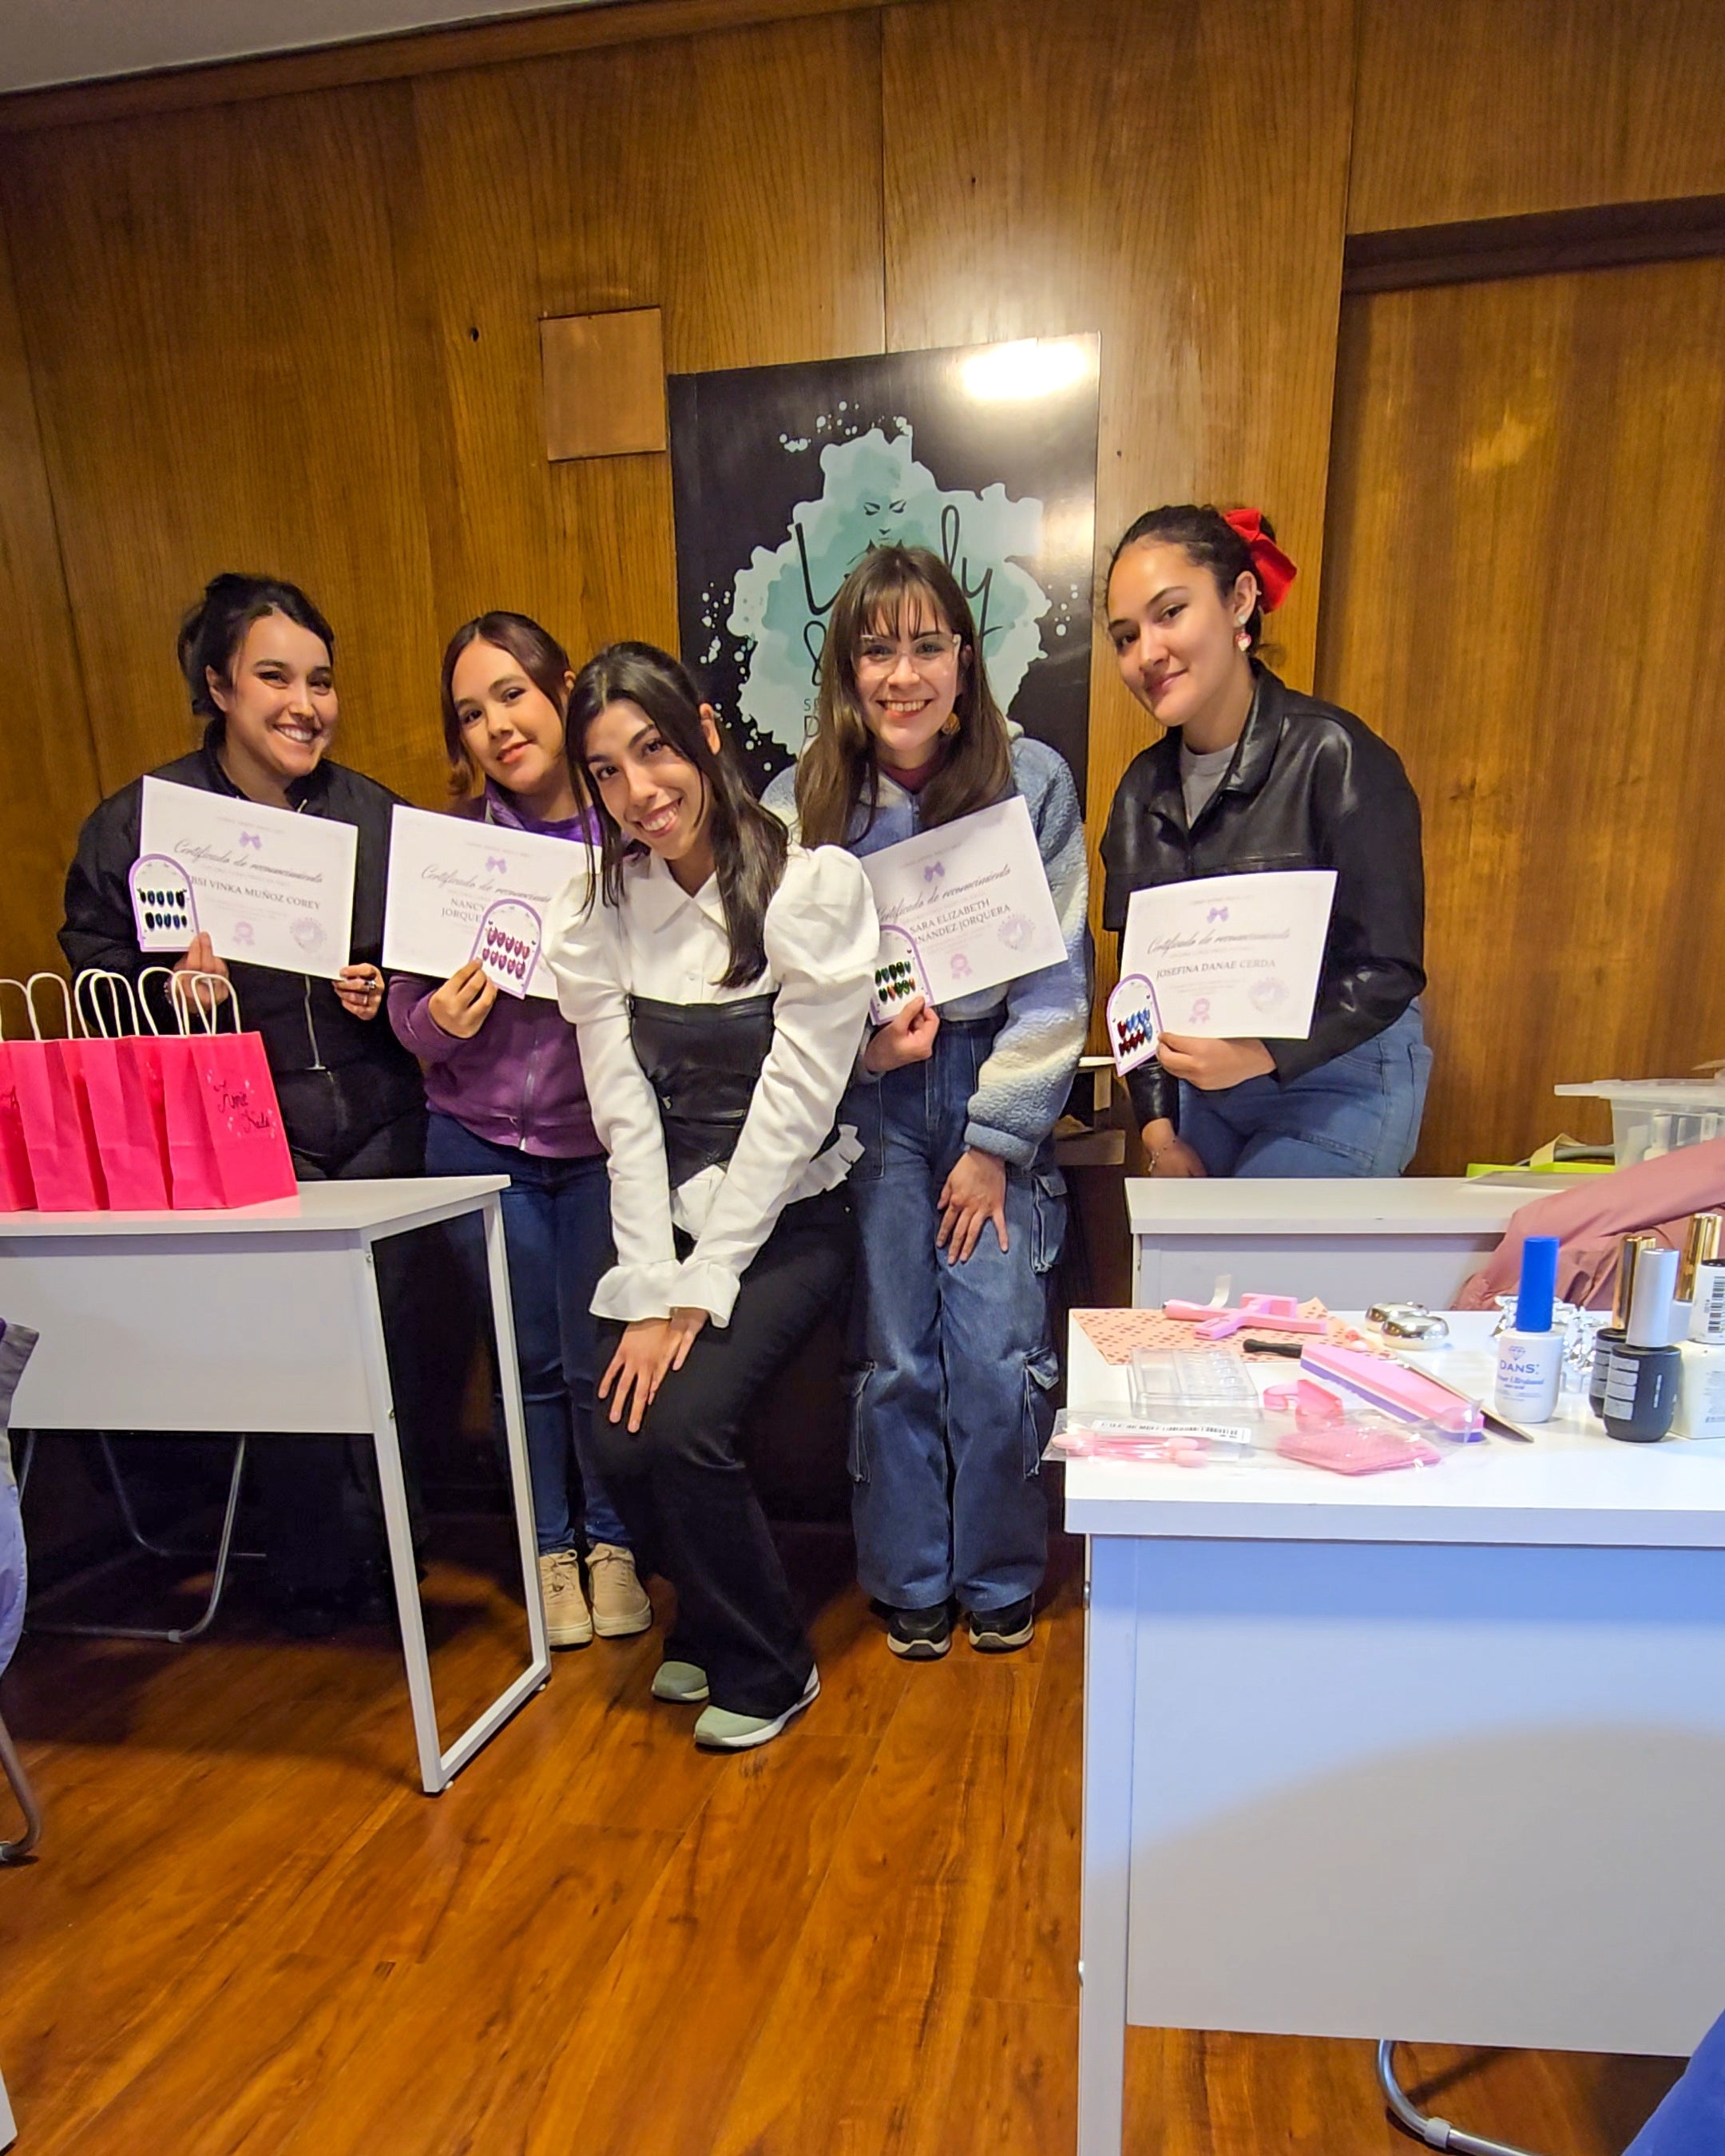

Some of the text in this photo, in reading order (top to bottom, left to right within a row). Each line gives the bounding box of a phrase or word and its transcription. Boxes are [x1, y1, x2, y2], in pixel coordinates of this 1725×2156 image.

[232, 854, 250, 866] de
[208, 879, 242, 895] VINKA
[244, 886, 284, 903] MUÑOZ
[285, 895, 321, 910] COREY
[478, 878, 495, 891] de
[450, 897, 485, 912] NANCY
[927, 886, 940, 904] de
[909, 919, 936, 933] SARA
[937, 898, 990, 927] ELIZABETH
[958, 904, 1011, 932] JORQUERA
[1156, 958, 1276, 981] JOSEFINA DANAE CERDA
